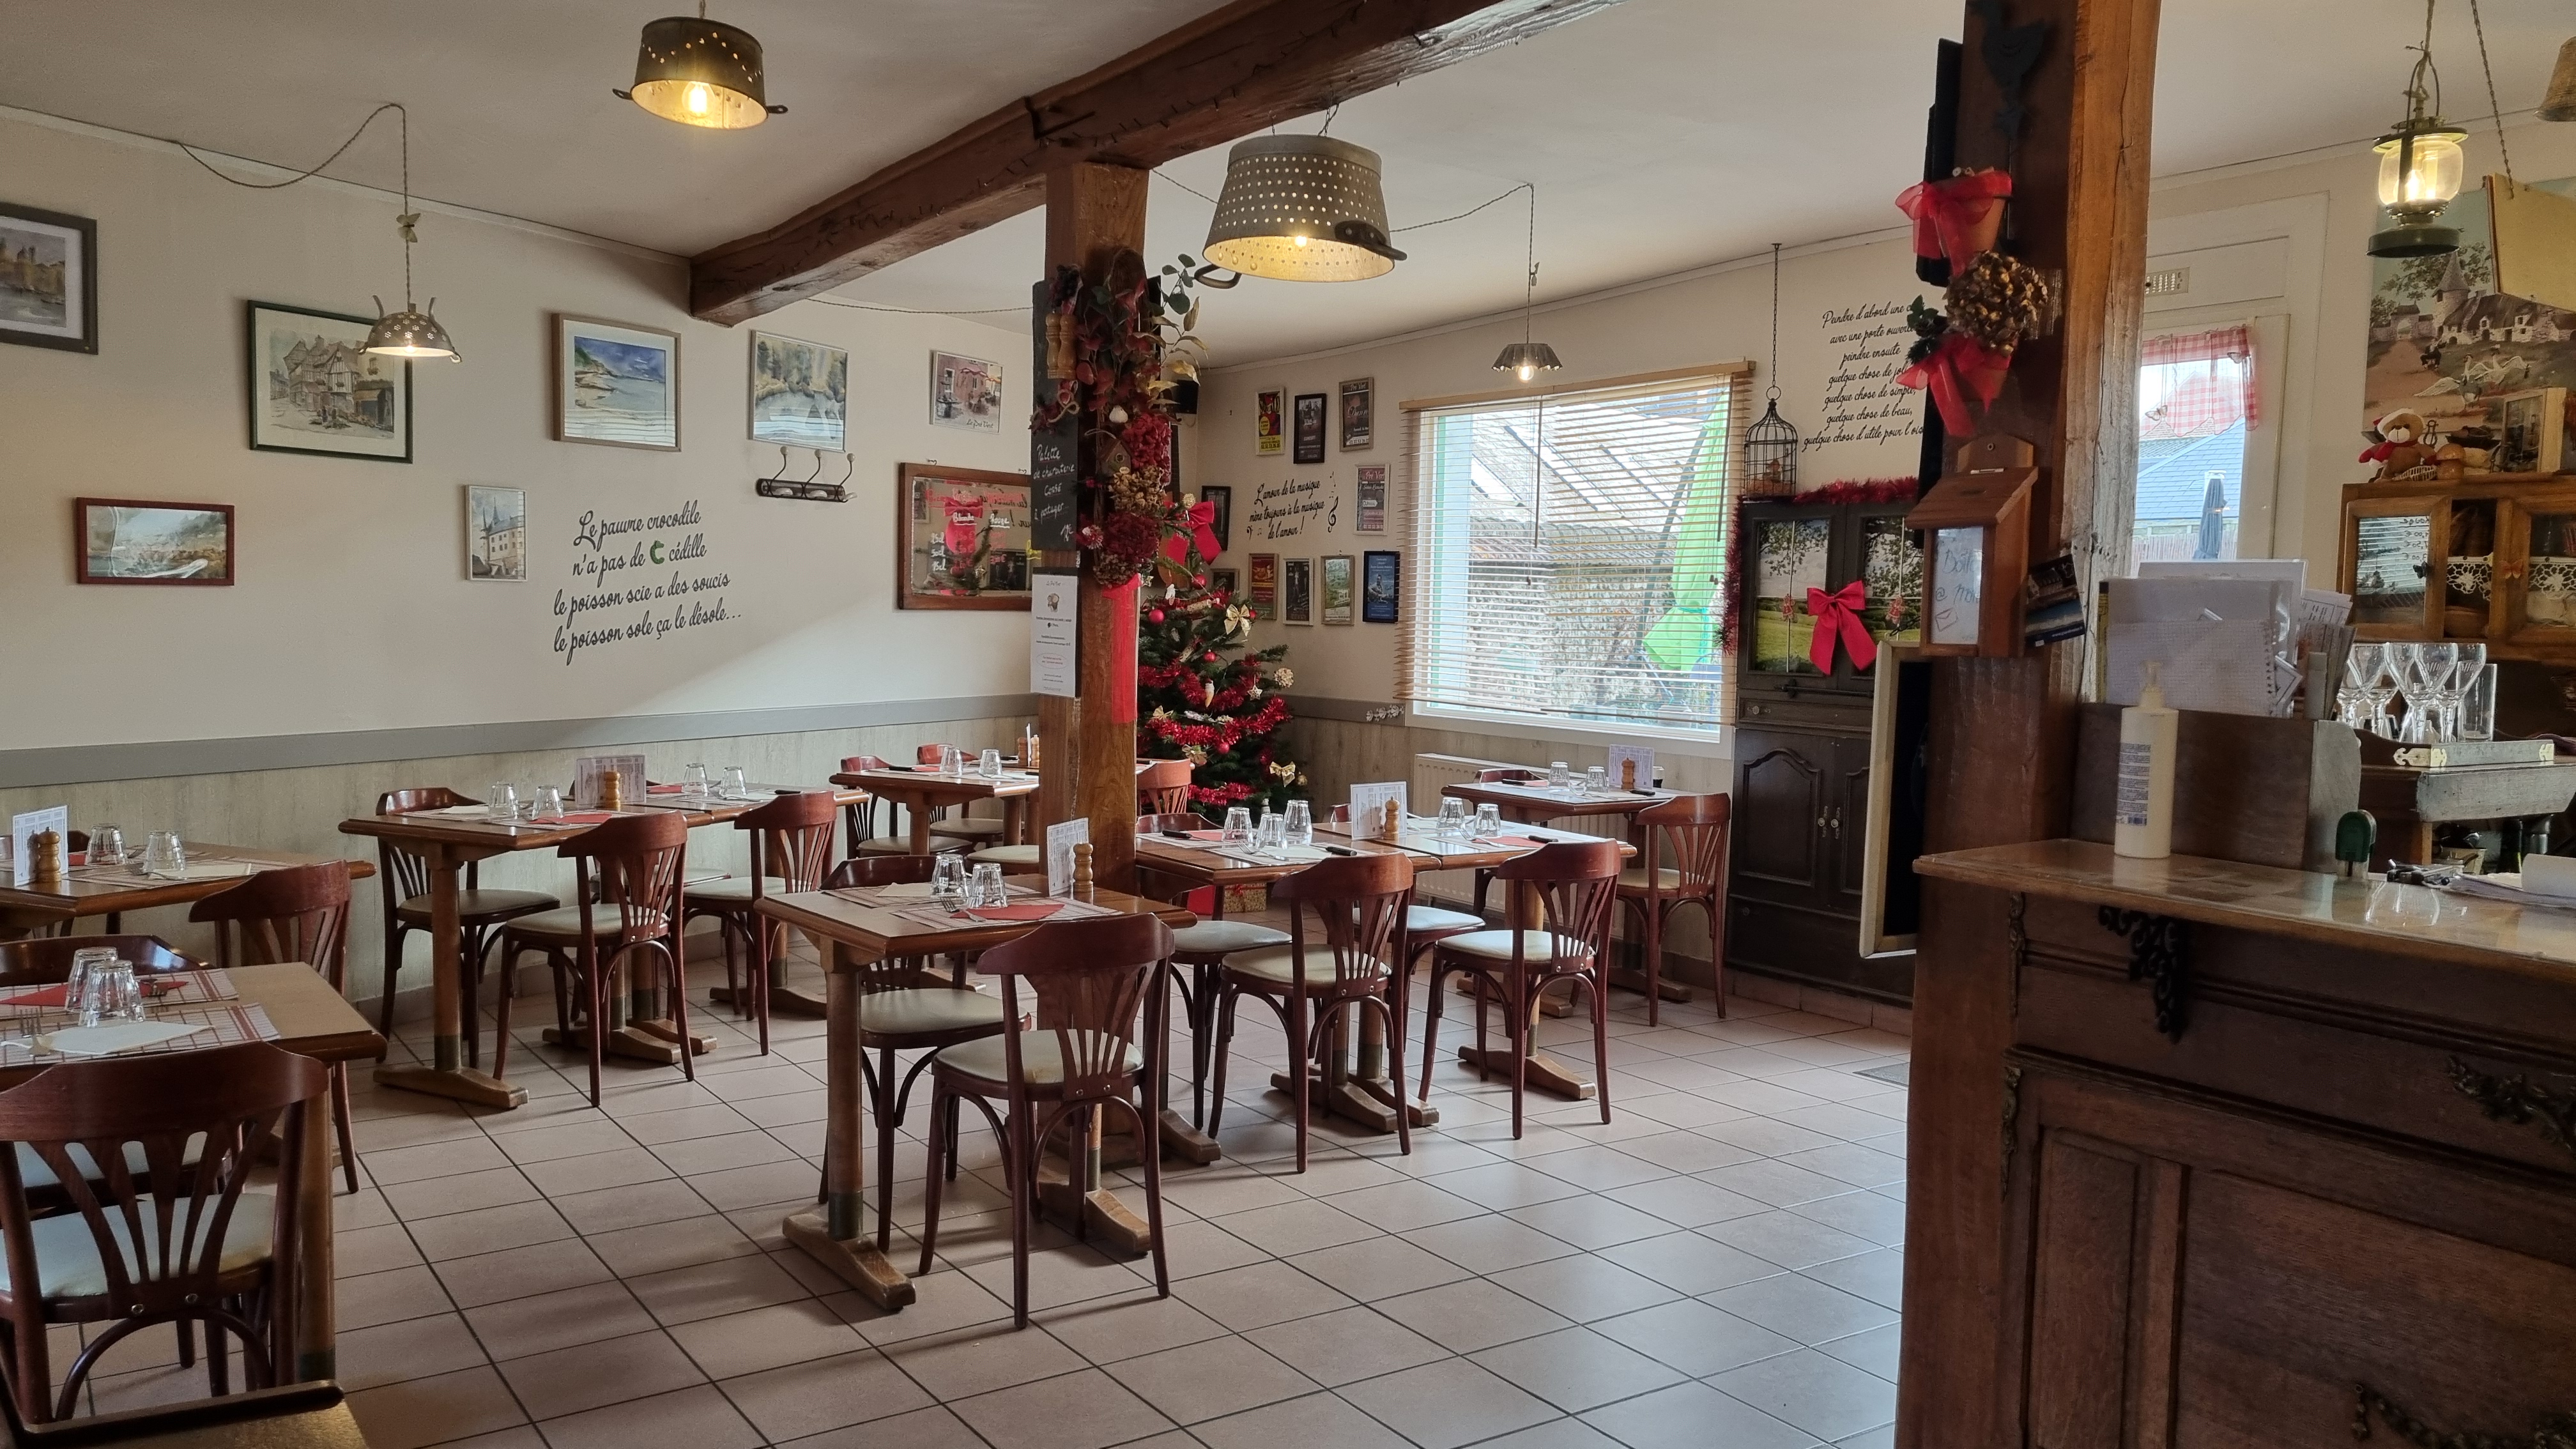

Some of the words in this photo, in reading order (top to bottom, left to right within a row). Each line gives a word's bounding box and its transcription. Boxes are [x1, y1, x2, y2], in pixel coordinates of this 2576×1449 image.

[1822, 308, 1854, 328] Peindre
[1890, 304, 1905, 314] une
[1830, 335, 1848, 344] avec
[1848, 332, 1864, 342] une
[1860, 324, 1885, 347] porte
[1839, 346, 1871, 370] peindre
[1872, 342, 1901, 358] ensuite
[1826, 368, 1857, 392] quelque
[1859, 365, 1881, 380] chose
[1882, 363, 1892, 376] de
[1889, 360, 1909, 384] jol
[1822, 385, 1853, 411] quelque
[1854, 386, 1876, 401] chose
[1878, 384, 1888, 397] de
[1824, 409, 1855, 431] quelque
[1857, 406, 1879, 420] chose
[1880, 404, 1890, 417] de
[1892, 402, 1913, 417] beau,
[1801, 431, 1832, 453] quelque
[1833, 429, 1855, 443] chose
[1880, 429, 1903, 446] pour
[1281, 480, 1289, 496] de
[1289, 479, 1296, 494] la
[1297, 480, 1321, 499] musique
[1287, 503, 1293, 515] à
[1293, 498, 1300, 514] la
[1301, 501, 1325, 520] musique
[573, 510, 598, 550] Le
[597, 519, 644, 552] pauvre
[647, 500, 702, 530] crocodile
[1268, 524, 1275, 539] de
[572, 554, 598, 576] n'a
[597, 554, 626, 588] pas
[629, 541, 645, 568] de
[669, 533, 707, 562] cédille
[554, 588, 567, 616] le
[567, 592, 624, 630] poisson
[626, 586, 652, 602] scie
[654, 586, 665, 598] a
[668, 571, 689, 596] des
[691, 572, 731, 591] soucis
[554, 625, 567, 653] le
[566, 629, 624, 666] poisson
[626, 610, 653, 637] sole
[656, 618, 672, 640] ça
[675, 604, 686, 630] le
